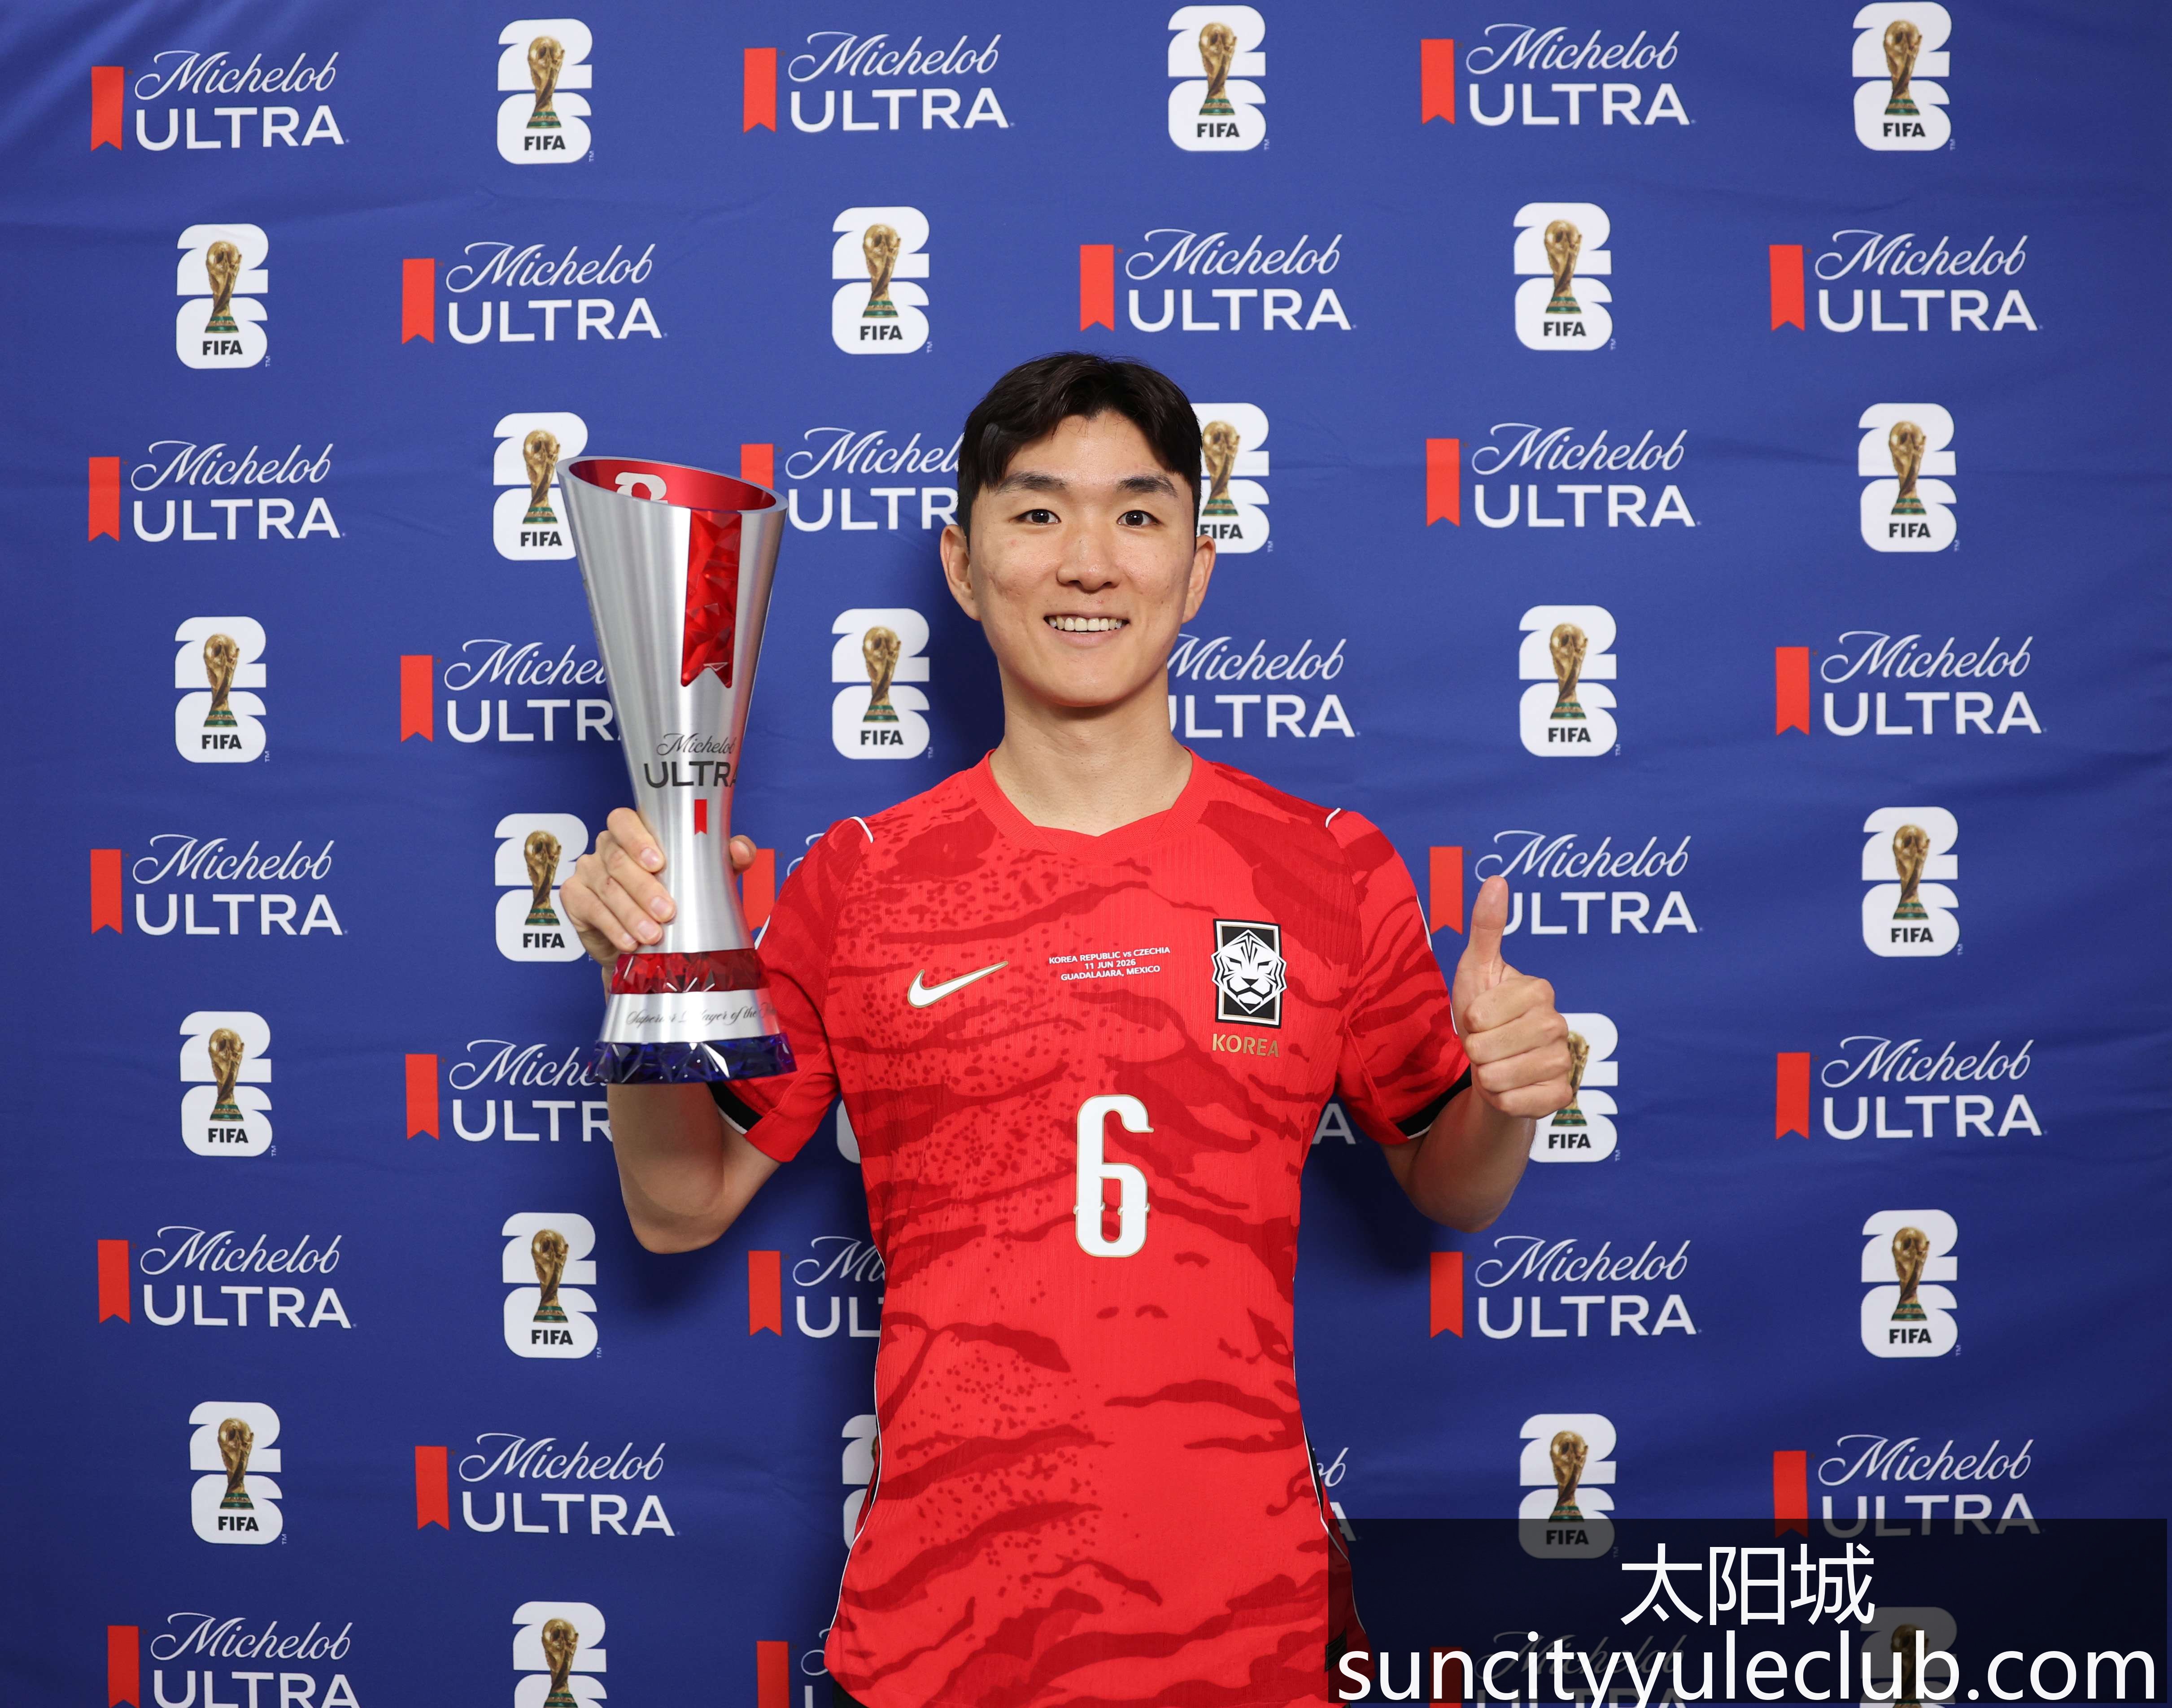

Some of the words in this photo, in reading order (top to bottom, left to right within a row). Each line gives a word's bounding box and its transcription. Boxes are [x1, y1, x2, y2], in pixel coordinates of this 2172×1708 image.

[788, 31, 1002, 83] Michelob
[1466, 23, 1679, 75] Michelob
[134, 50, 339, 100] Michelob
[790, 87, 1009, 133] ULTRA
[1469, 83, 1690, 126] ULTRA
[136, 105, 345, 151] ULTRA
[525, 136, 565, 150] FIFA
[1197, 123, 1239, 137] FIFA
[1884, 123, 1925, 137] FIFA
[446, 241, 656, 293] Michelob
[1125, 228, 1343, 280] Michelob
[1814, 229, 2028, 280] Michelob
[448, 297, 663, 344] ULTRA
[1128, 288, 1352, 333] ULTRA
[1544, 322, 1586, 336] FIFA
[1819, 289, 2038, 333] ULTRA
[203, 340, 243, 355] FIFA
[860, 326, 902, 340] FIFA
[131, 440, 333, 492] Michelob
[785, 427, 965, 479] Michel
[1471, 423, 1688, 475] Michelob
[133, 497, 340, 542] ULTRA
[788, 487, 959, 532] ULTR
[1474, 484, 1696, 528] ULTRA
[521, 532, 562, 546] FIFA
[1200, 524, 1243, 539] FIFA
[1889, 523, 1930, 537] FIFA
[444, 639, 606, 691] Miche
[1820, 631, 2033, 684] Michelob
[447, 699, 621, 743] ULTR
[1167, 694, 1355, 738] LTRA
[1548, 728, 1591, 742] FIFA
[1823, 691, 2042, 736] ULTRA
[202, 735, 242, 749] FIFA
[861, 730, 903, 745] FIFA
[132, 834, 335, 884] Michelob
[1475, 830, 1691, 883] Michelob
[135, 893, 343, 936] ULTRA
[1891, 928, 1933, 942] FIFA
[523, 933, 565, 948] FIFA
[1049, 956, 1078, 964] KOREA
[1080, 951, 1121, 961] REPUBLIC
[1133, 947, 1170, 957] CZECHIA
[1061, 969, 1124, 981] GUADALAJARA,
[1126, 965, 1160, 975] MEXICO
[1116, 959, 1136, 967] 2026
[724, 1006, 748, 1025] of
[743, 1006, 757, 1019] the
[1212, 1033, 1279, 1058] KOREA
[1821, 1036, 2033, 1088] Michelob
[208, 1128, 249, 1143] FIFA
[453, 1099, 613, 1142] ULTR
[1823, 1094, 2042, 1140] ULTRA
[1548, 1134, 1591, 1149] FIFA
[1073, 1094, 1154, 1258] 6
[140, 1226, 342, 1275] Michelob
[1475, 1235, 1691, 1287] Michelob
[144, 1284, 352, 1329] ULTRA
[1478, 1294, 1697, 1339] ULTRA
[532, 1329, 573, 1345] FIFA
[1889, 1329, 1932, 1344] FIFA
[459, 1433, 666, 1482] Michelob
[1818, 1434, 2033, 1486] Michelob
[218, 1516, 259, 1531] FIFA
[462, 1491, 675, 1536] ULTRA
[1546, 1530, 1589, 1545] FIFA
[150, 1612, 353, 1660] Michelob
[154, 1670, 360, 1708] ULTRA
